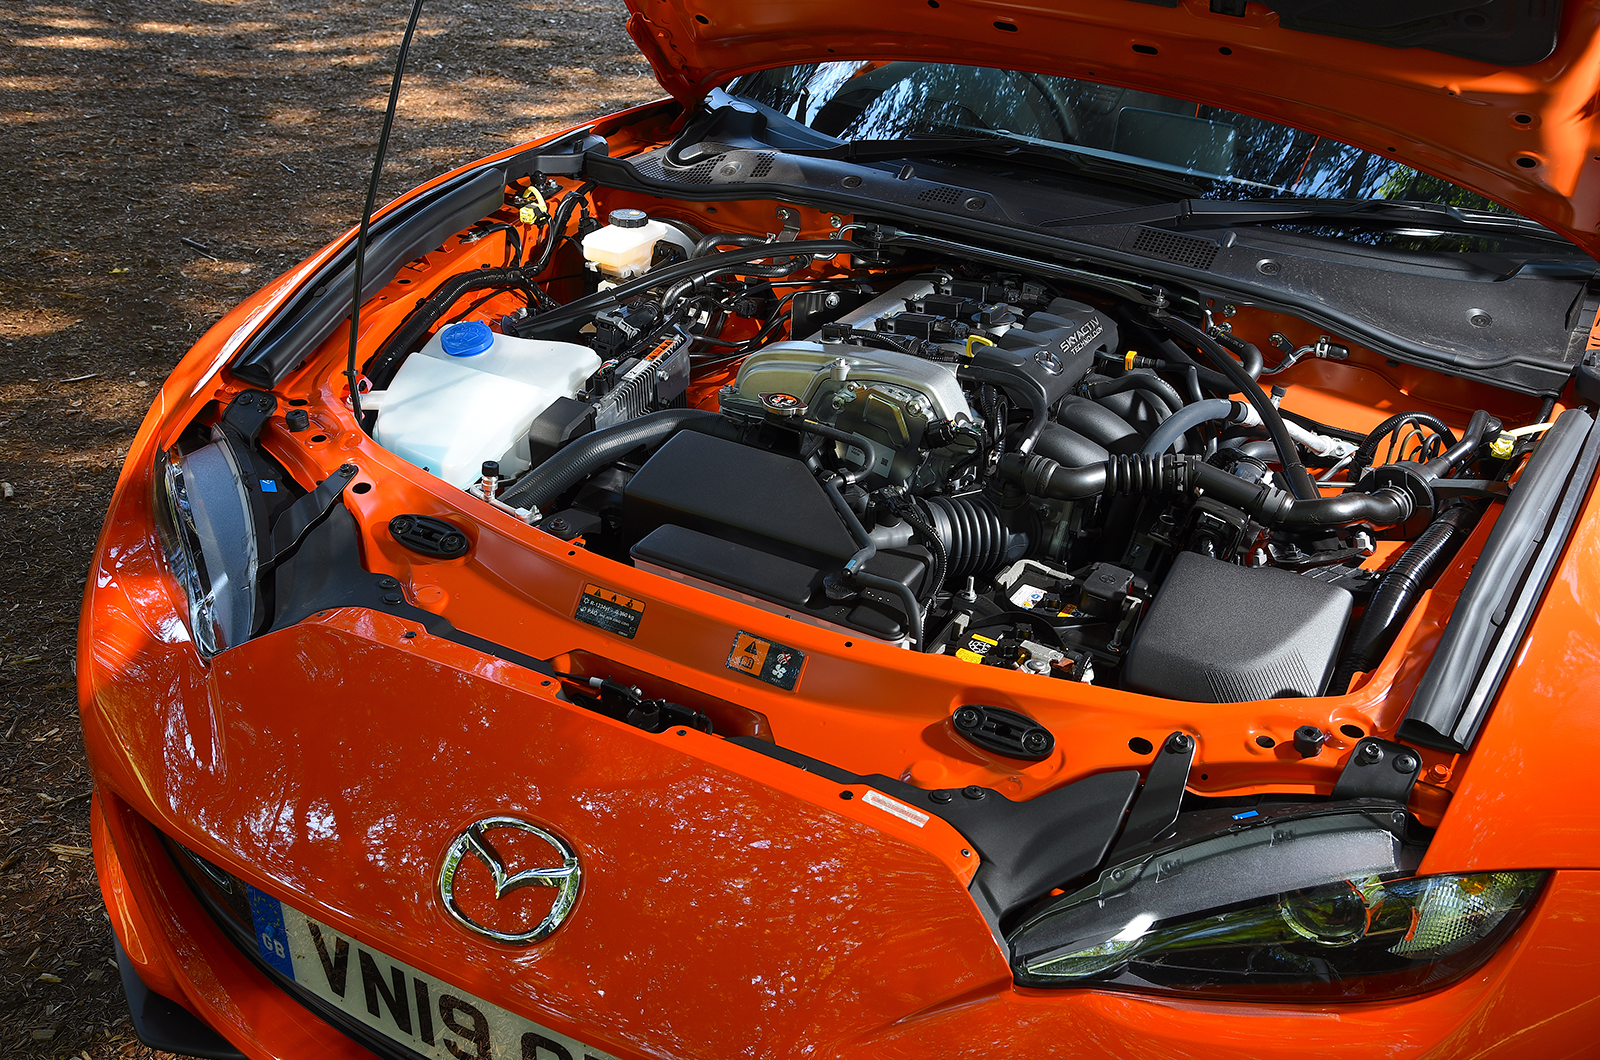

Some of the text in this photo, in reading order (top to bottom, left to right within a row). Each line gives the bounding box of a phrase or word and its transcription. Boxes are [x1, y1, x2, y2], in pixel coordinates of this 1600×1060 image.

[1060, 316, 1100, 353] SKYACTIV
[1071, 325, 1104, 355] TECHNOLOGY
[262, 932, 286, 959] GB
